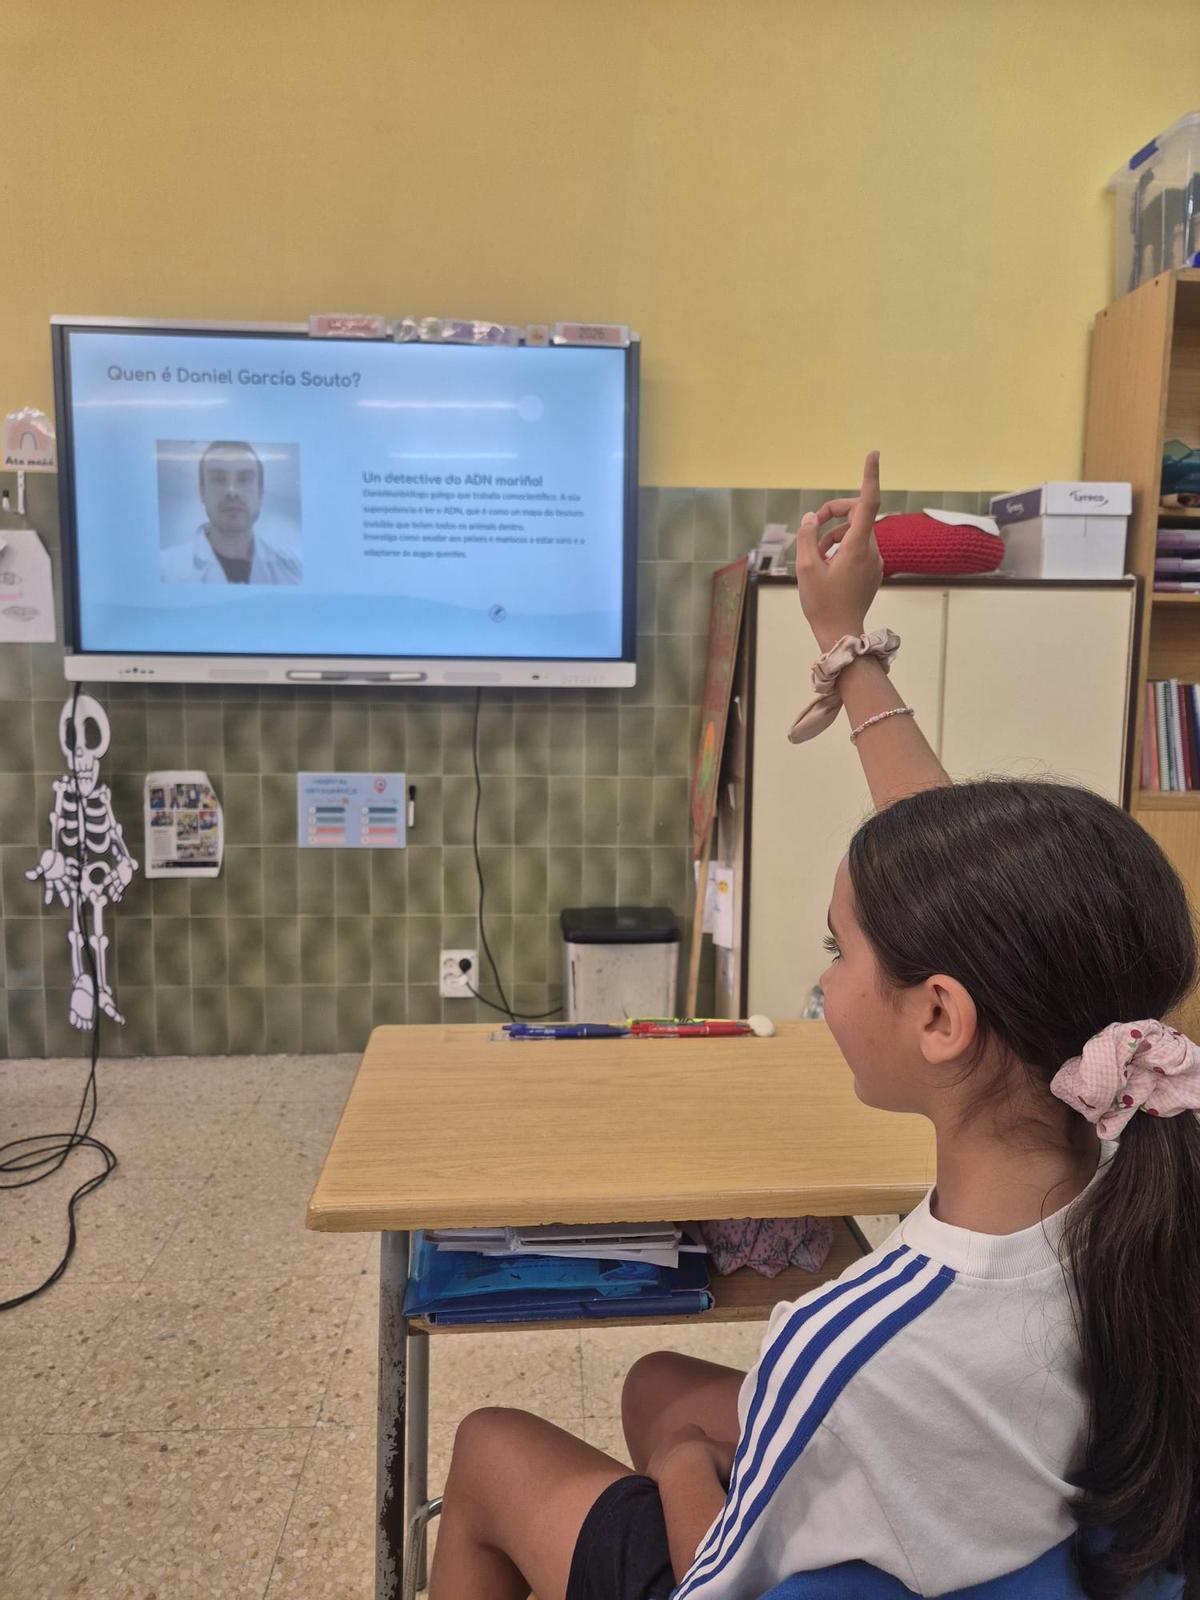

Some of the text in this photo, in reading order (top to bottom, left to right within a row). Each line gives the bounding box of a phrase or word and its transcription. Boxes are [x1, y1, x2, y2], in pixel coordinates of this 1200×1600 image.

[107, 365, 361, 388] Quen é Daniel García Souto?
[363, 471, 382, 484] Un
[384, 472, 442, 485] detective
[445, 474, 462, 486] do
[464, 473, 492, 486] ADN
